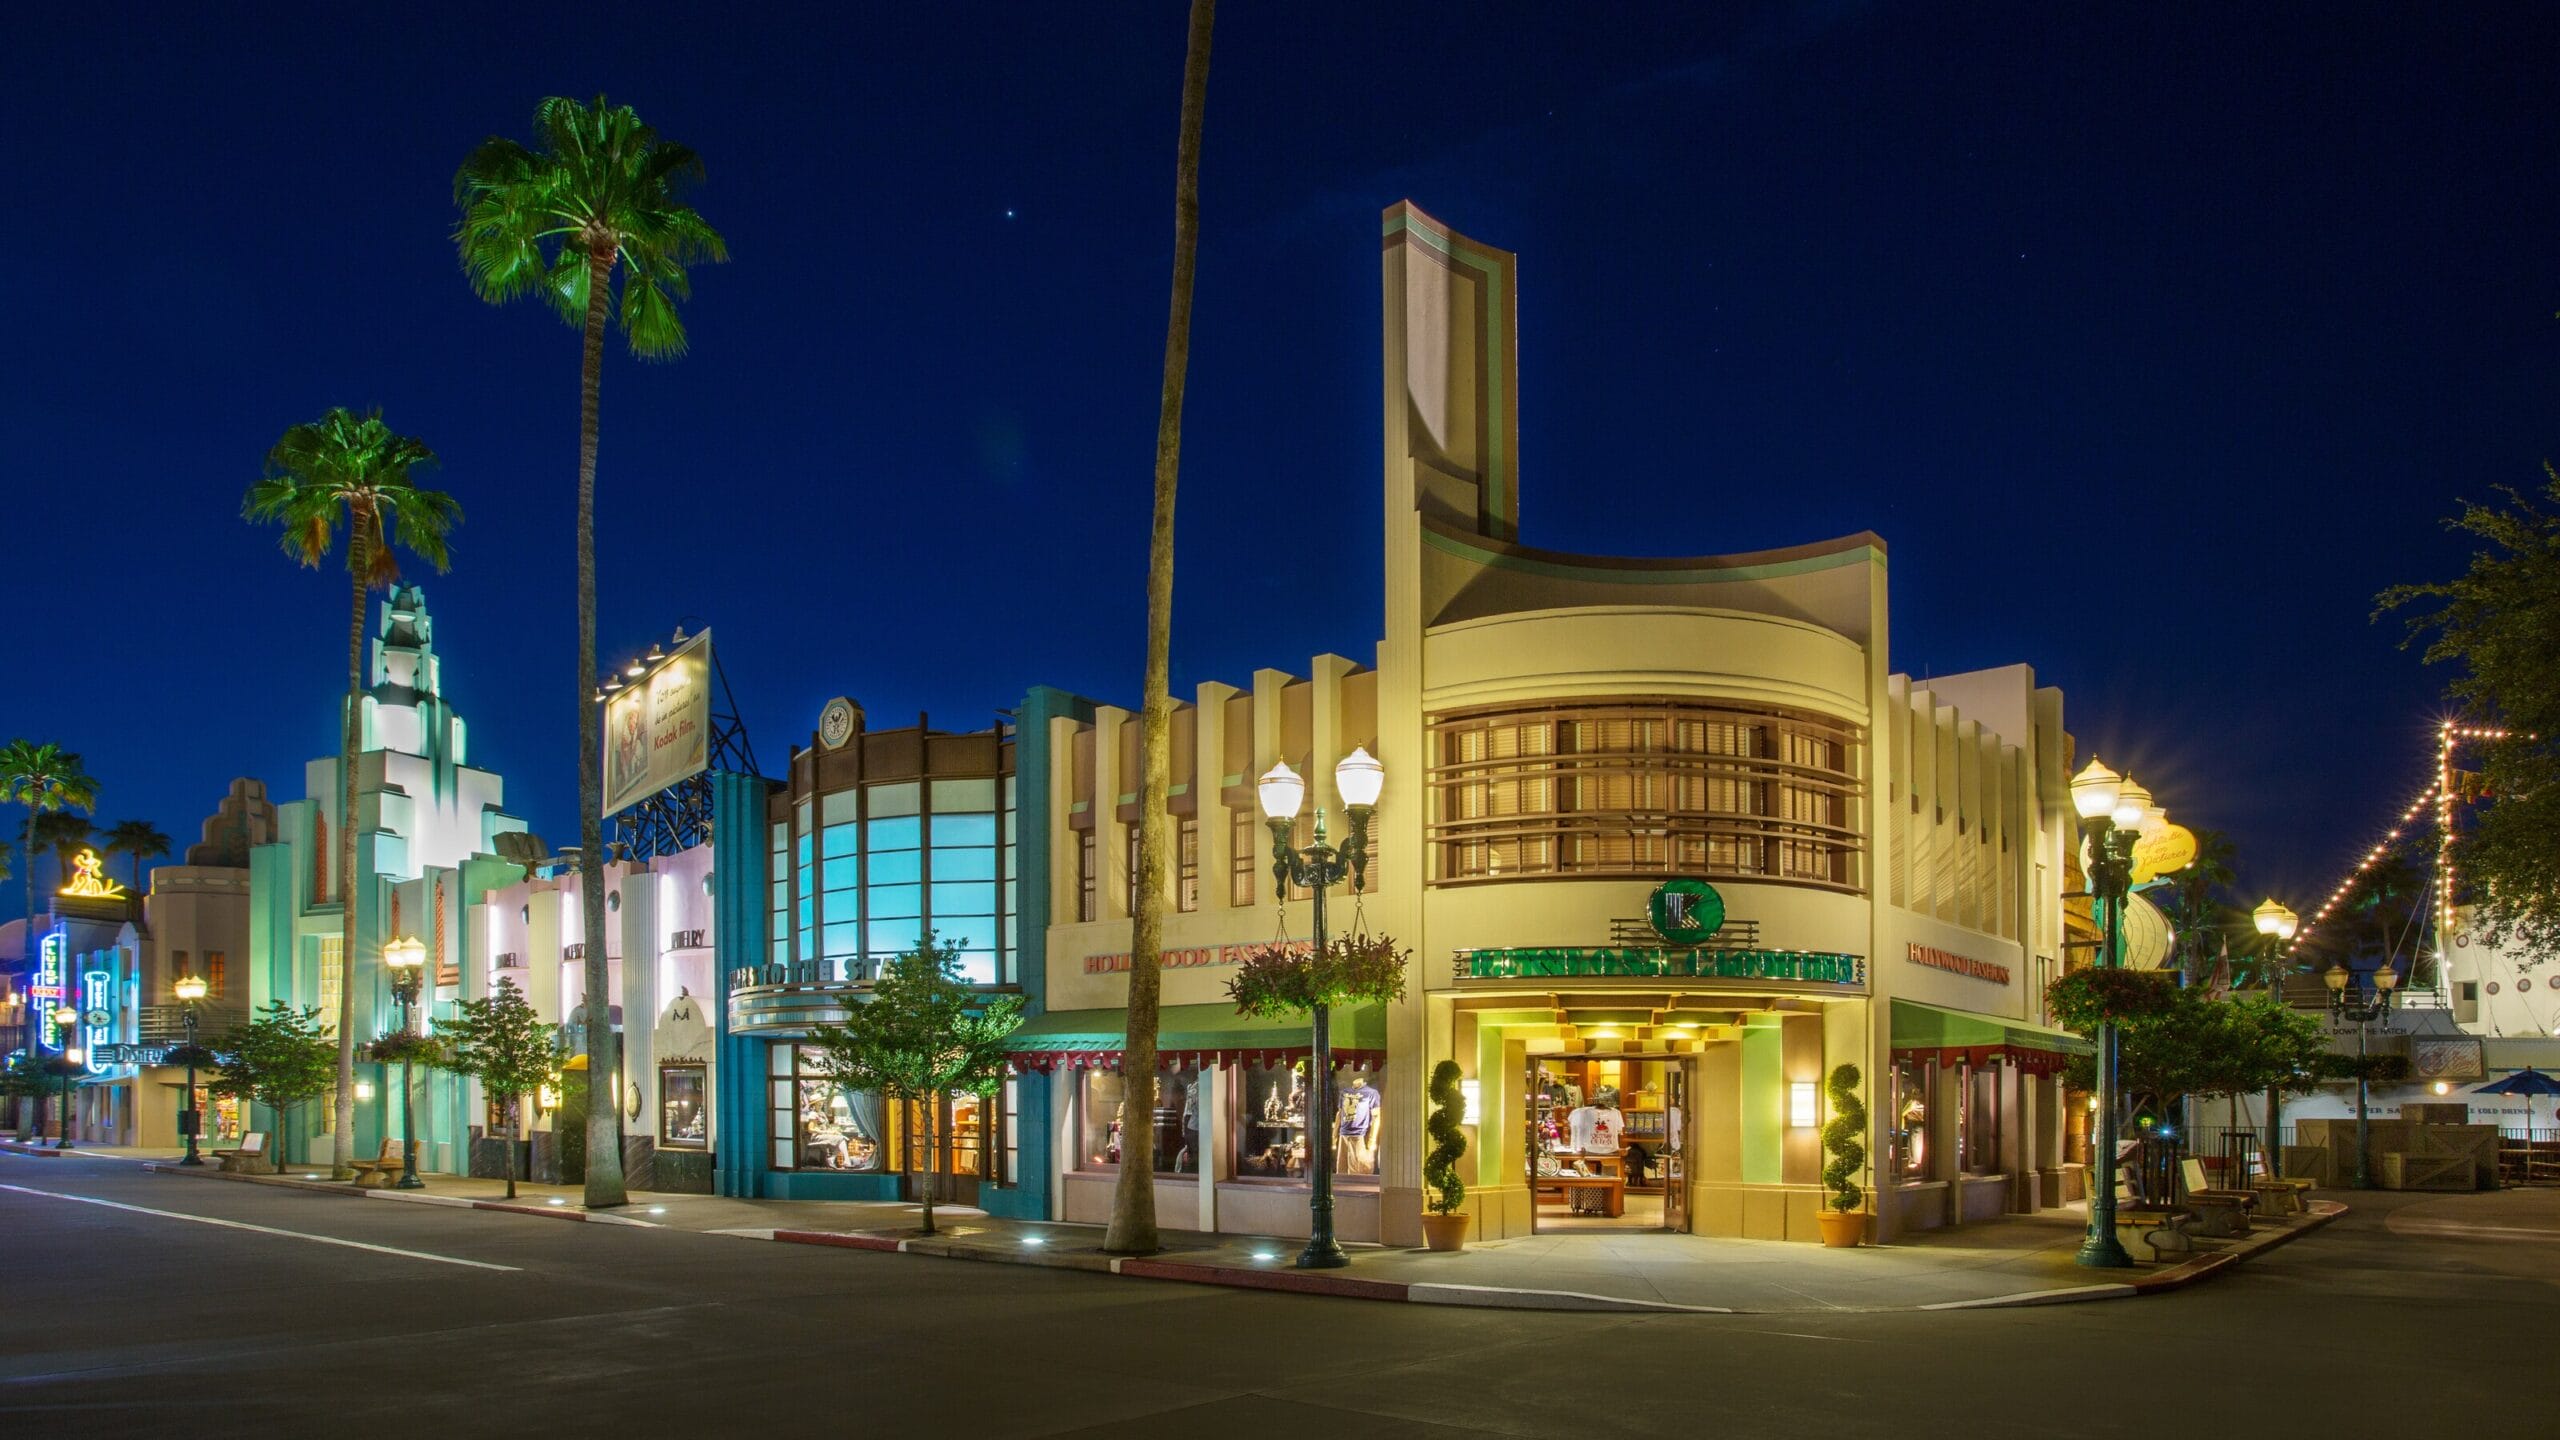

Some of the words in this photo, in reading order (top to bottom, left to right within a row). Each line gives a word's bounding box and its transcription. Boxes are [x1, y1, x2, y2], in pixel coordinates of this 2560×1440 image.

[654, 725, 678, 751] Kodak
[1907, 942, 1969, 973] HOLLYWOOD
[761, 962, 786, 985] TO
[789, 959, 835, 984] THE
